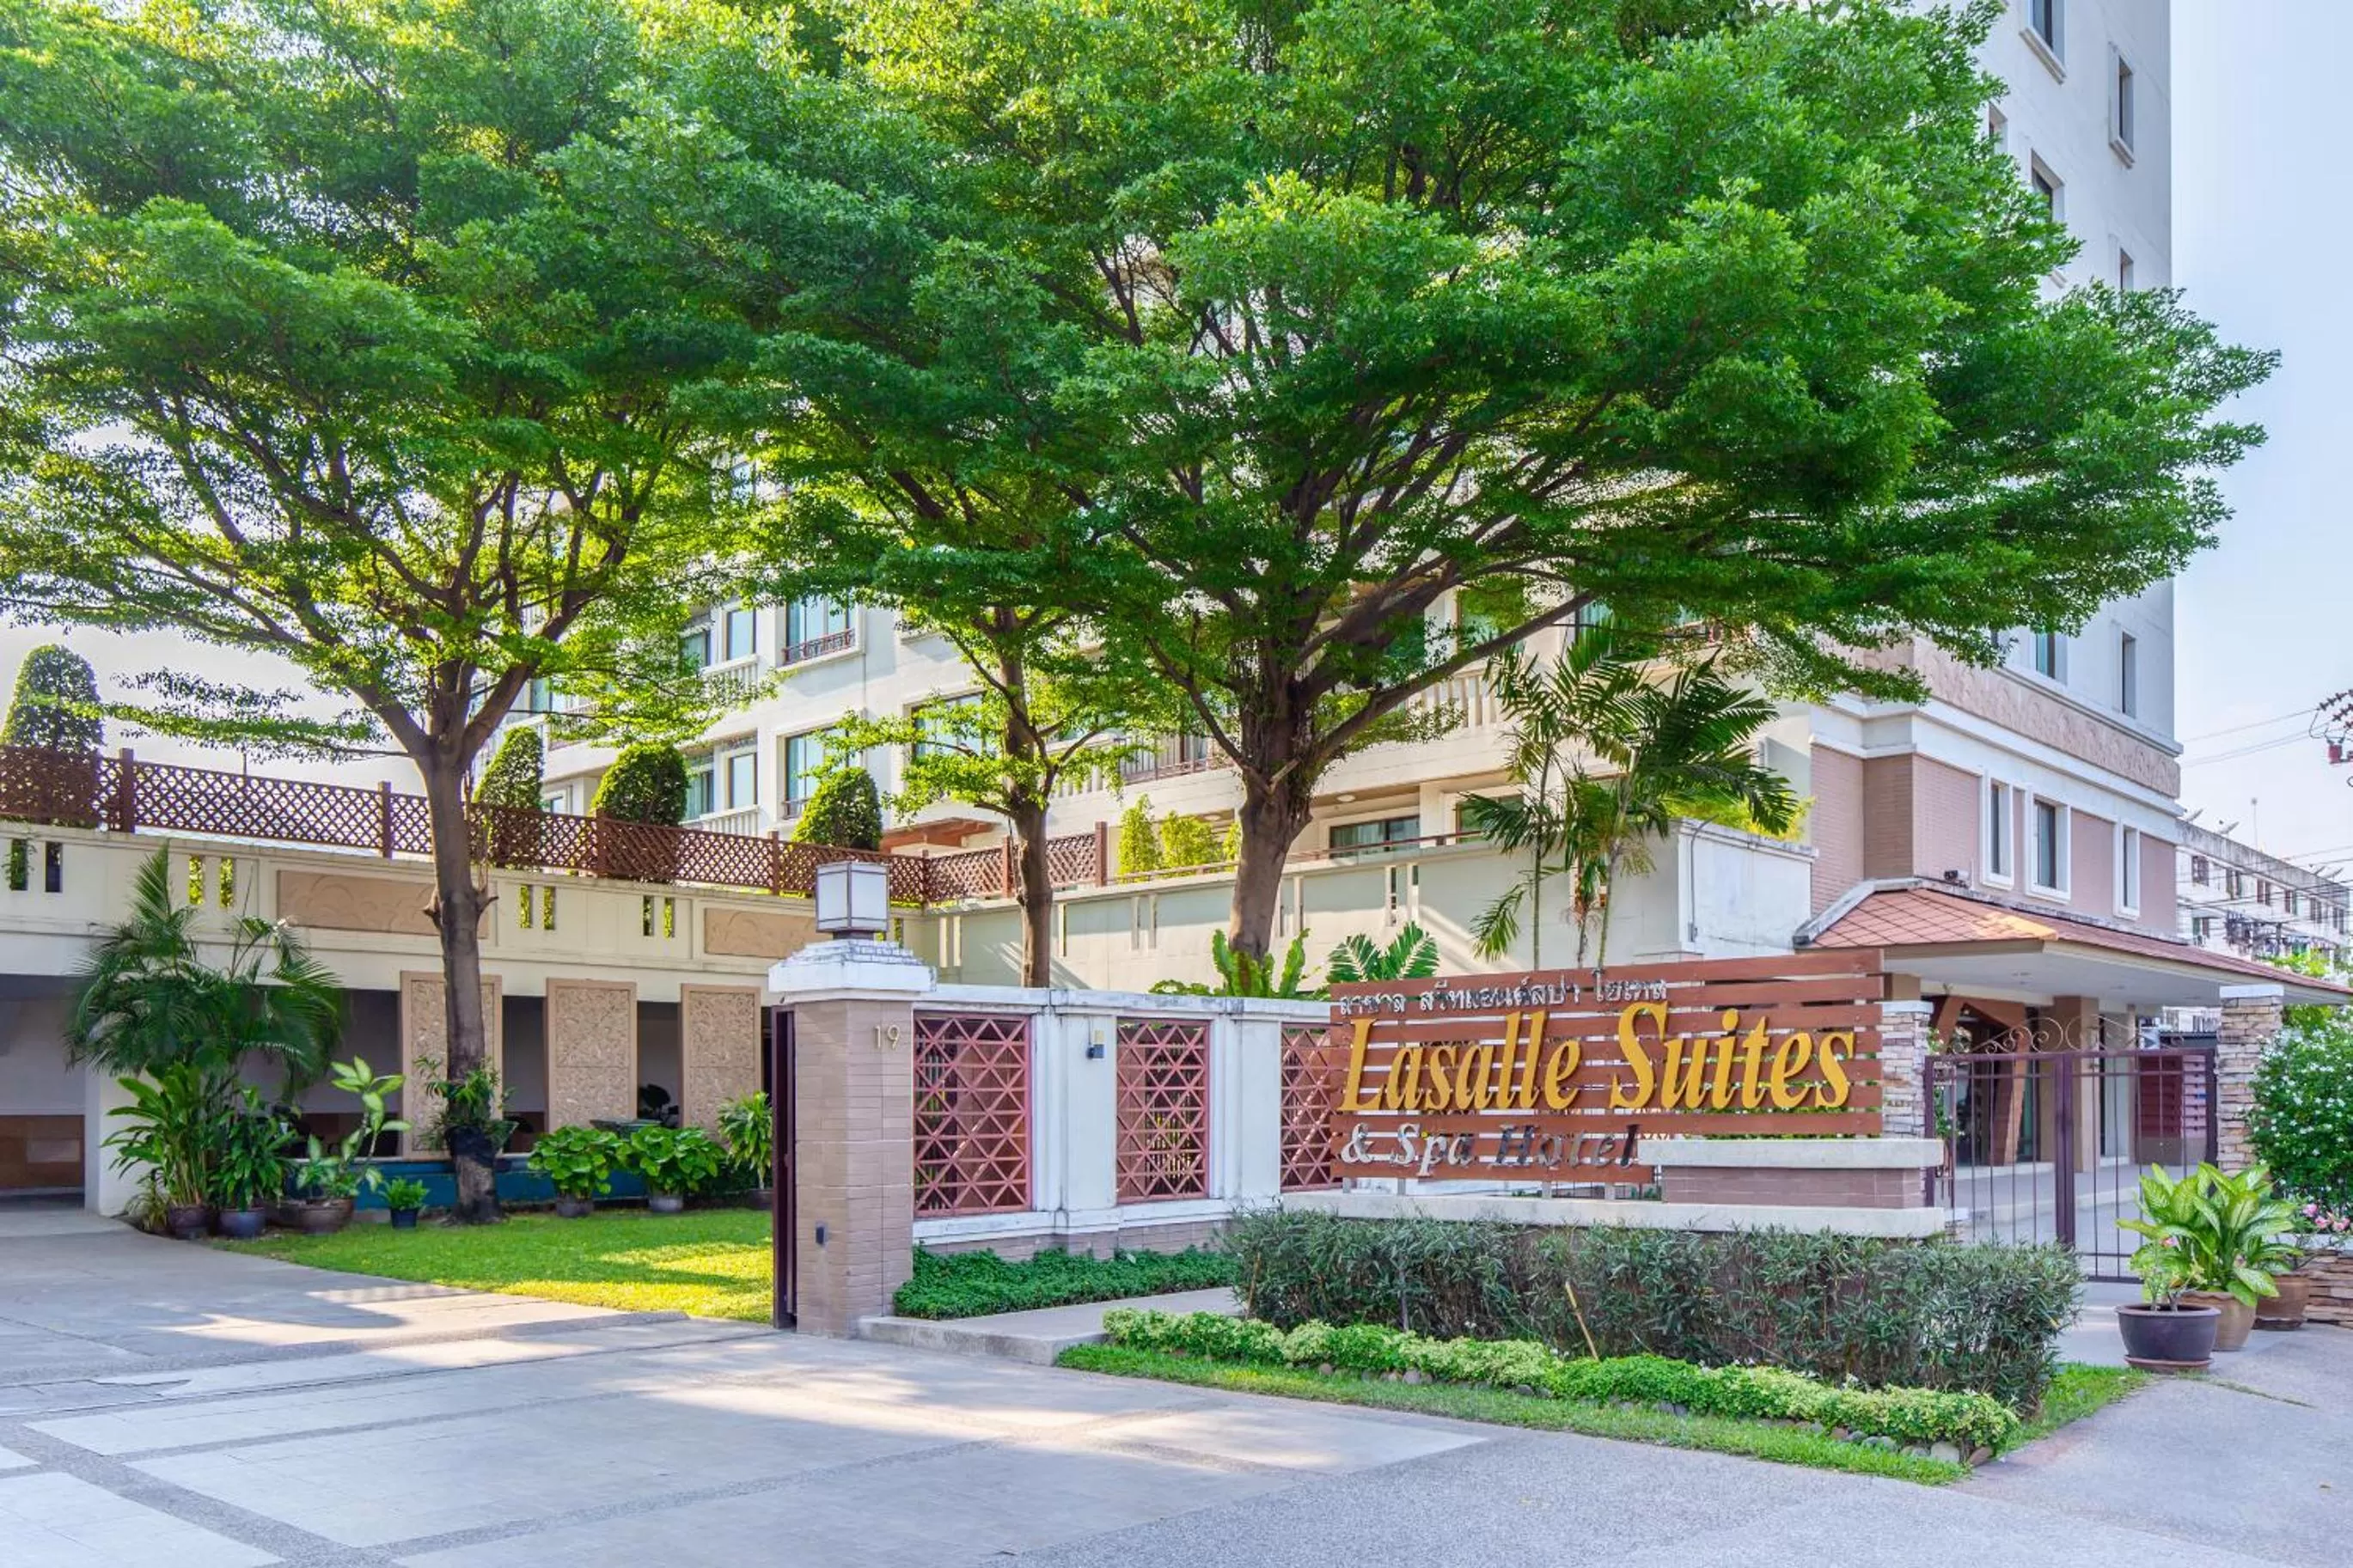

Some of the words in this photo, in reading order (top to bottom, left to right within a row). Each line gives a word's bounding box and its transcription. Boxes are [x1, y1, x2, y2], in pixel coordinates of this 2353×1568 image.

[875, 1024, 900, 1050] 19
[1337, 1010, 1581, 1111] Lasalle
[1610, 1001, 1854, 1108] Suites
[1342, 1122, 1375, 1163] &
[1390, 1122, 1475, 1176] Spa
[1488, 1124, 1640, 1169] Hotel
